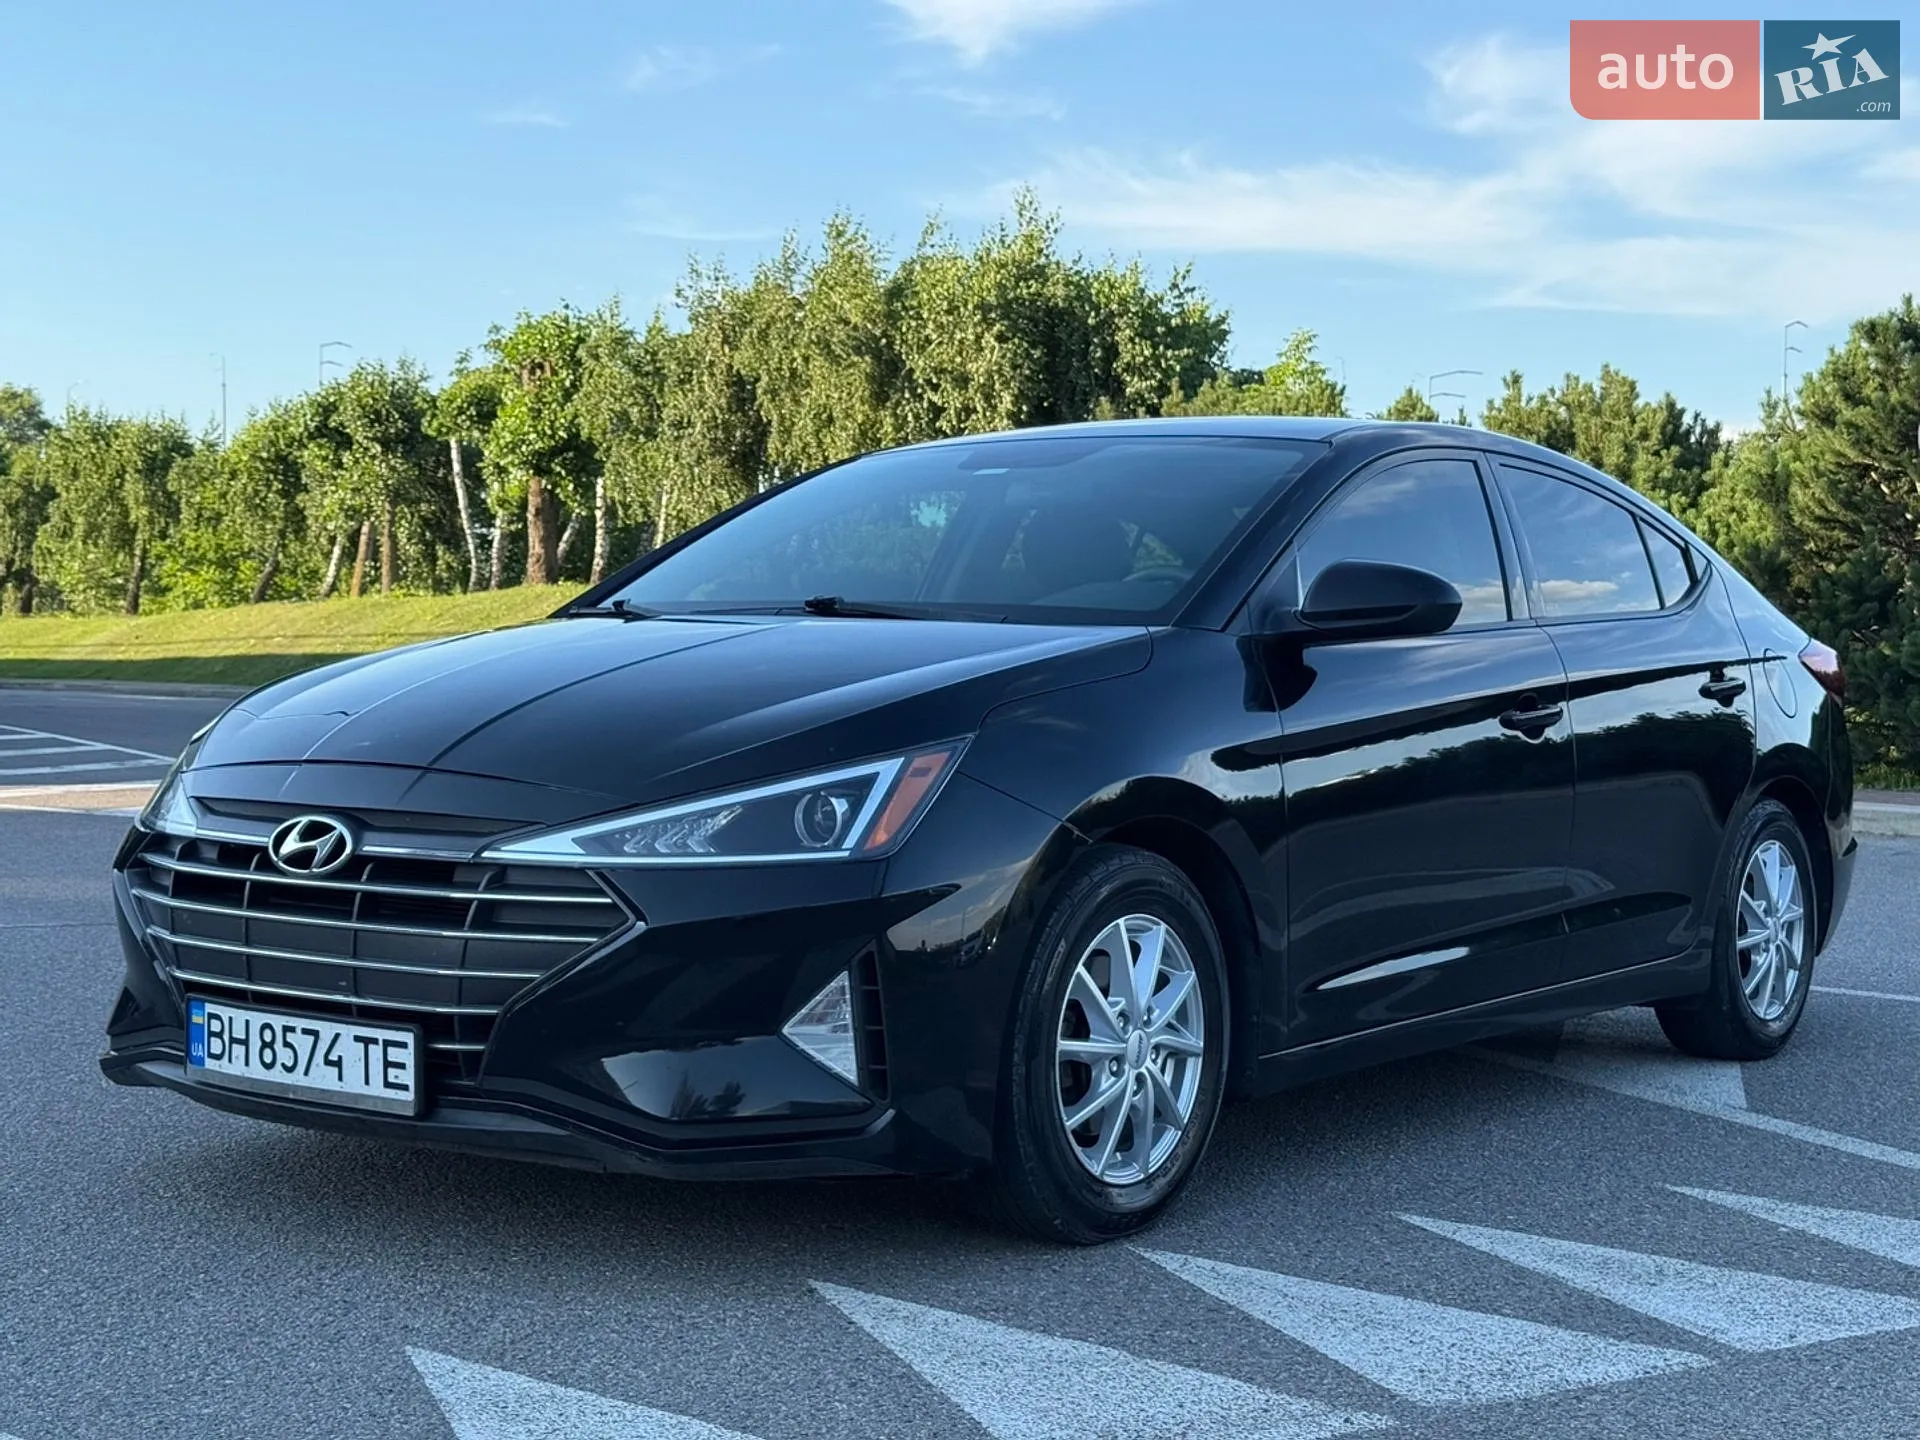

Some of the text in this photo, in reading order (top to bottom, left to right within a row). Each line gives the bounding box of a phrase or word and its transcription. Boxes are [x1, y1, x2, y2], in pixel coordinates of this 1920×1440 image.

[191, 1043, 204, 1057] UA
[206, 1012, 410, 1092] BH 8574 TE
